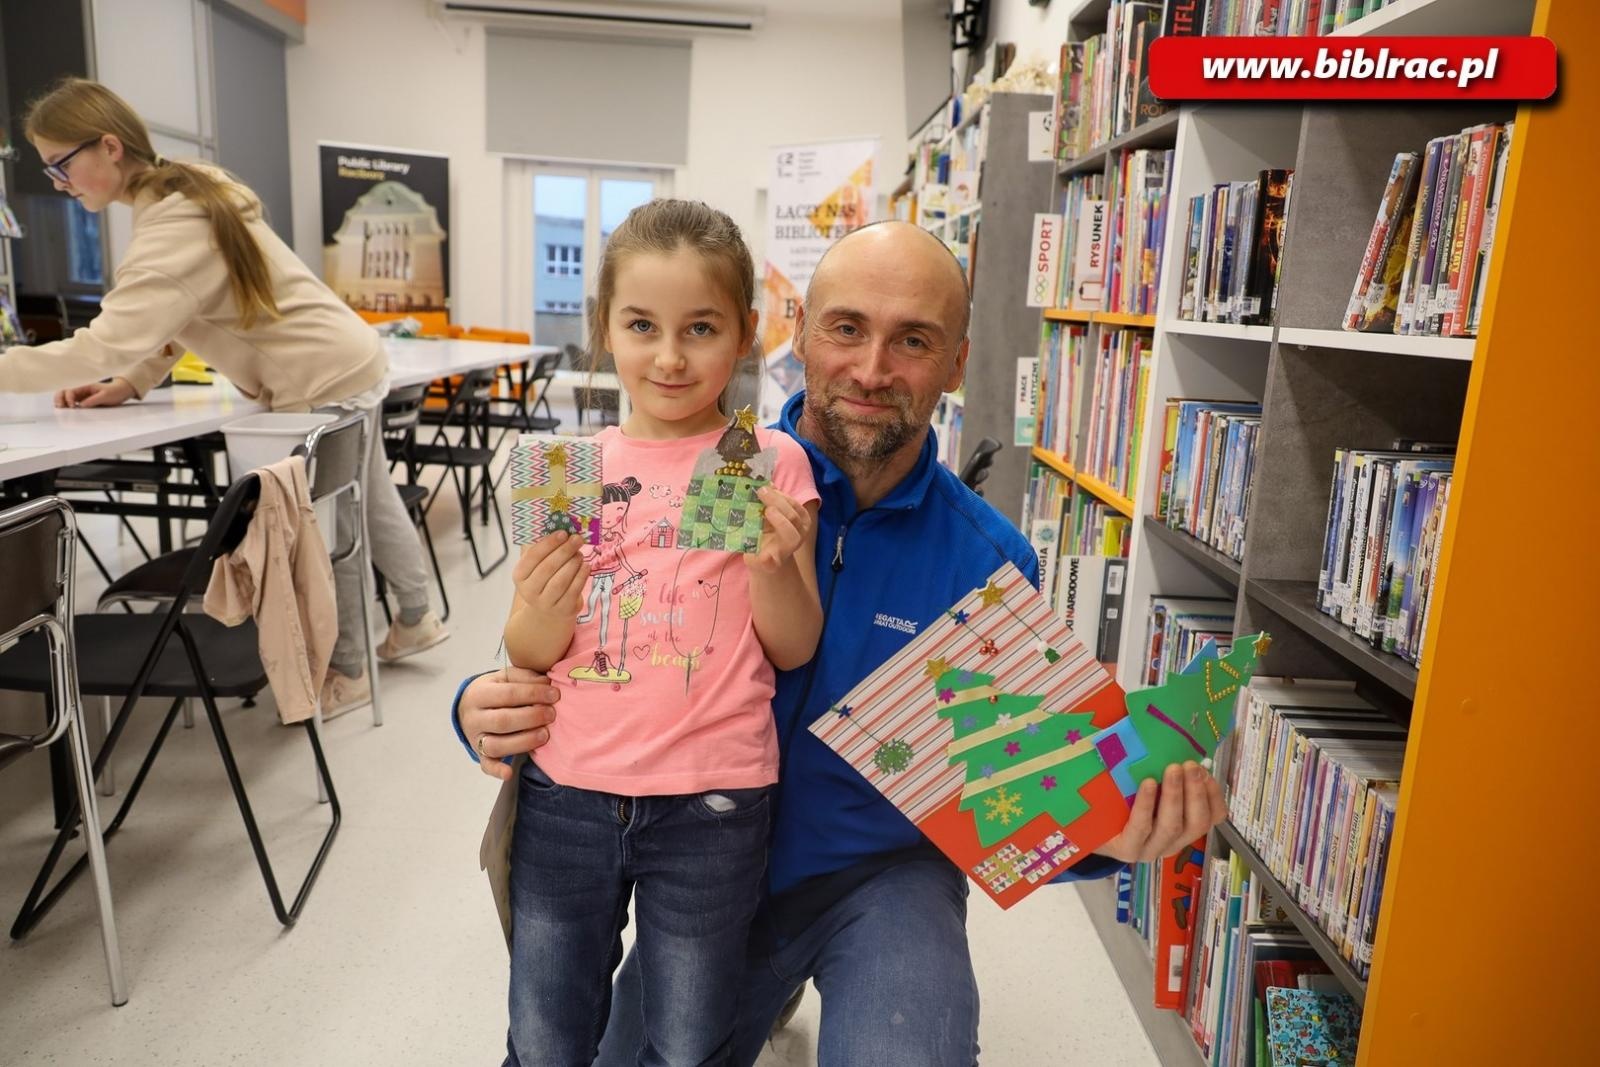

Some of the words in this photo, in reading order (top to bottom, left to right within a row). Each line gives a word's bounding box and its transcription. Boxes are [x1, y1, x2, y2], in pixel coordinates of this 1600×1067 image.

[338, 155, 371, 169] Public
[372, 158, 410, 175] Library
[825, 203, 857, 218] NAS
[1037, 218, 1053, 273] SPORT
[1090, 204, 1104, 268] RYSUNEK
[1020, 374, 1028, 403] PRACE
[659, 583, 686, 606] life
[1066, 558, 1080, 619] NARODOWE
[640, 607, 686, 627] sweet
[651, 642, 702, 671] beach
